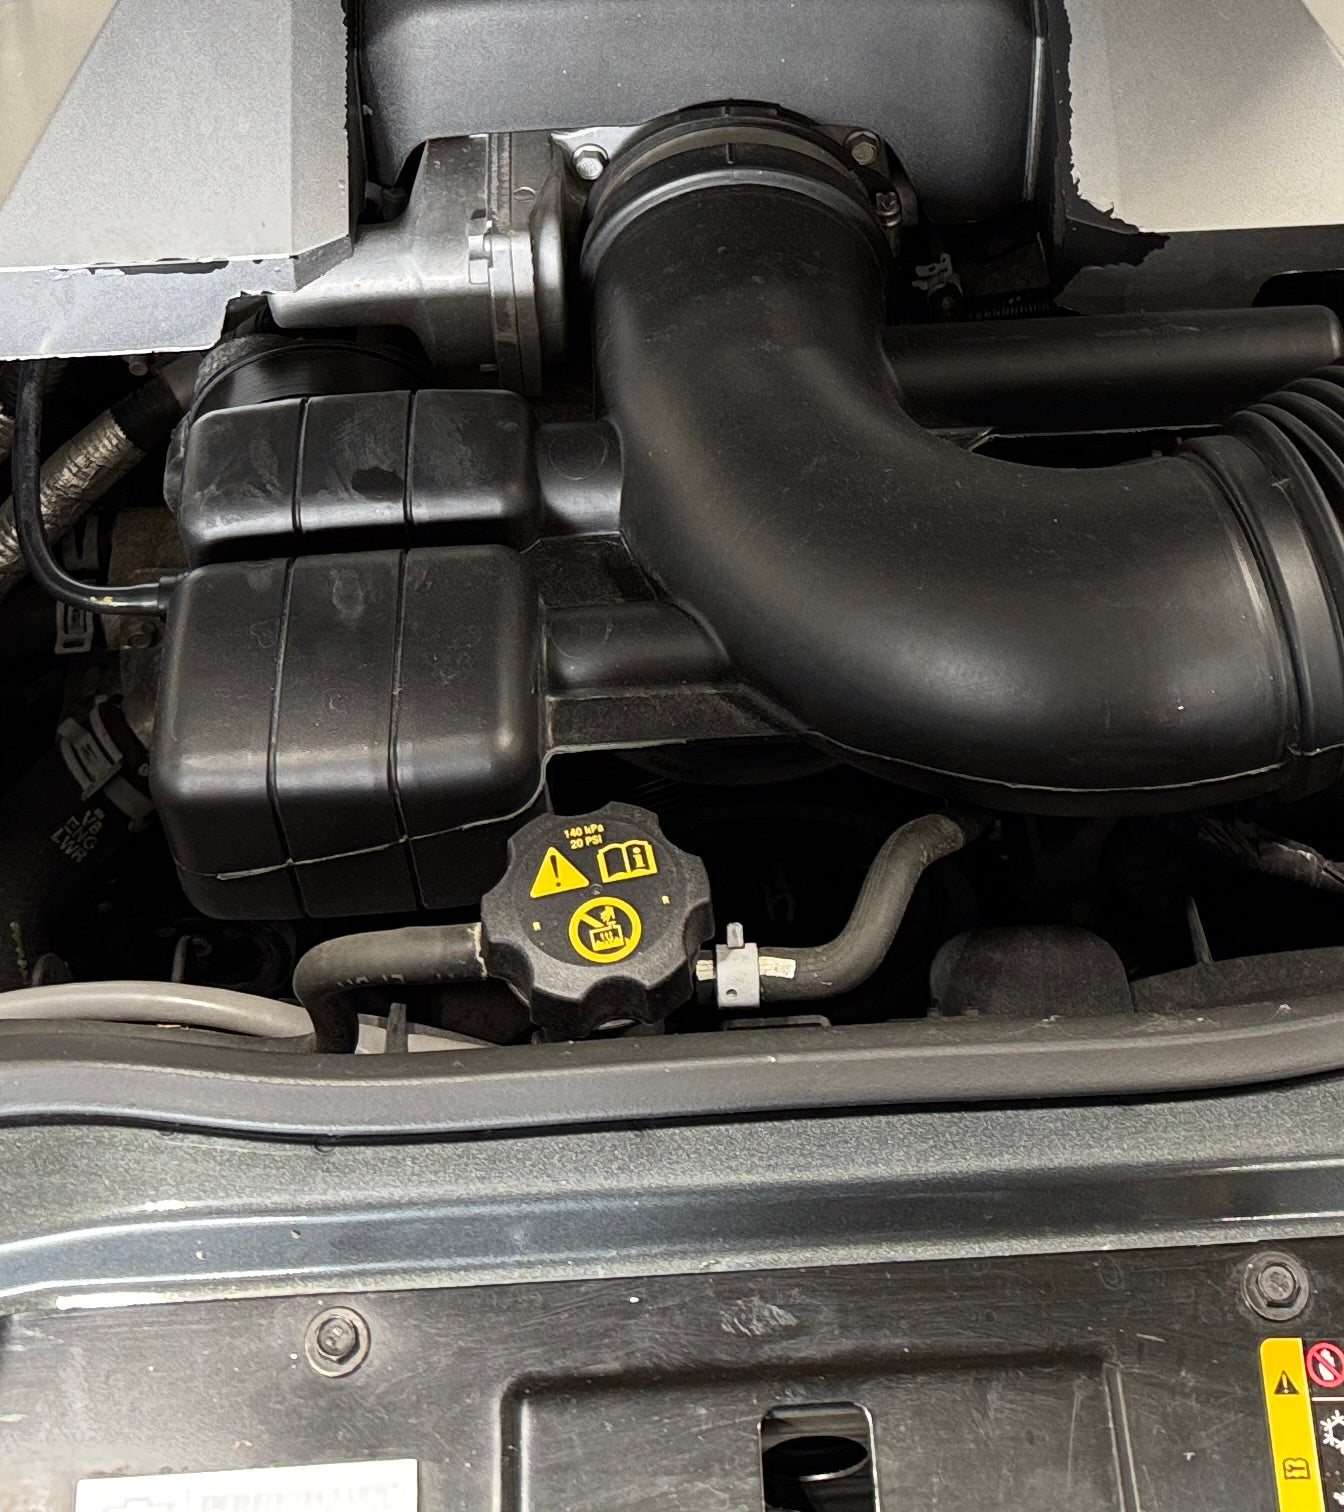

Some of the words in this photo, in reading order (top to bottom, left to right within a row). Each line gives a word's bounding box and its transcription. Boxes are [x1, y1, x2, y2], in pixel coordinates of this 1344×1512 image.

[563, 826, 583, 839] 140
[584, 823, 605, 835] kPa
[569, 838, 584, 850] 20
[585, 834, 603, 846] PSI
